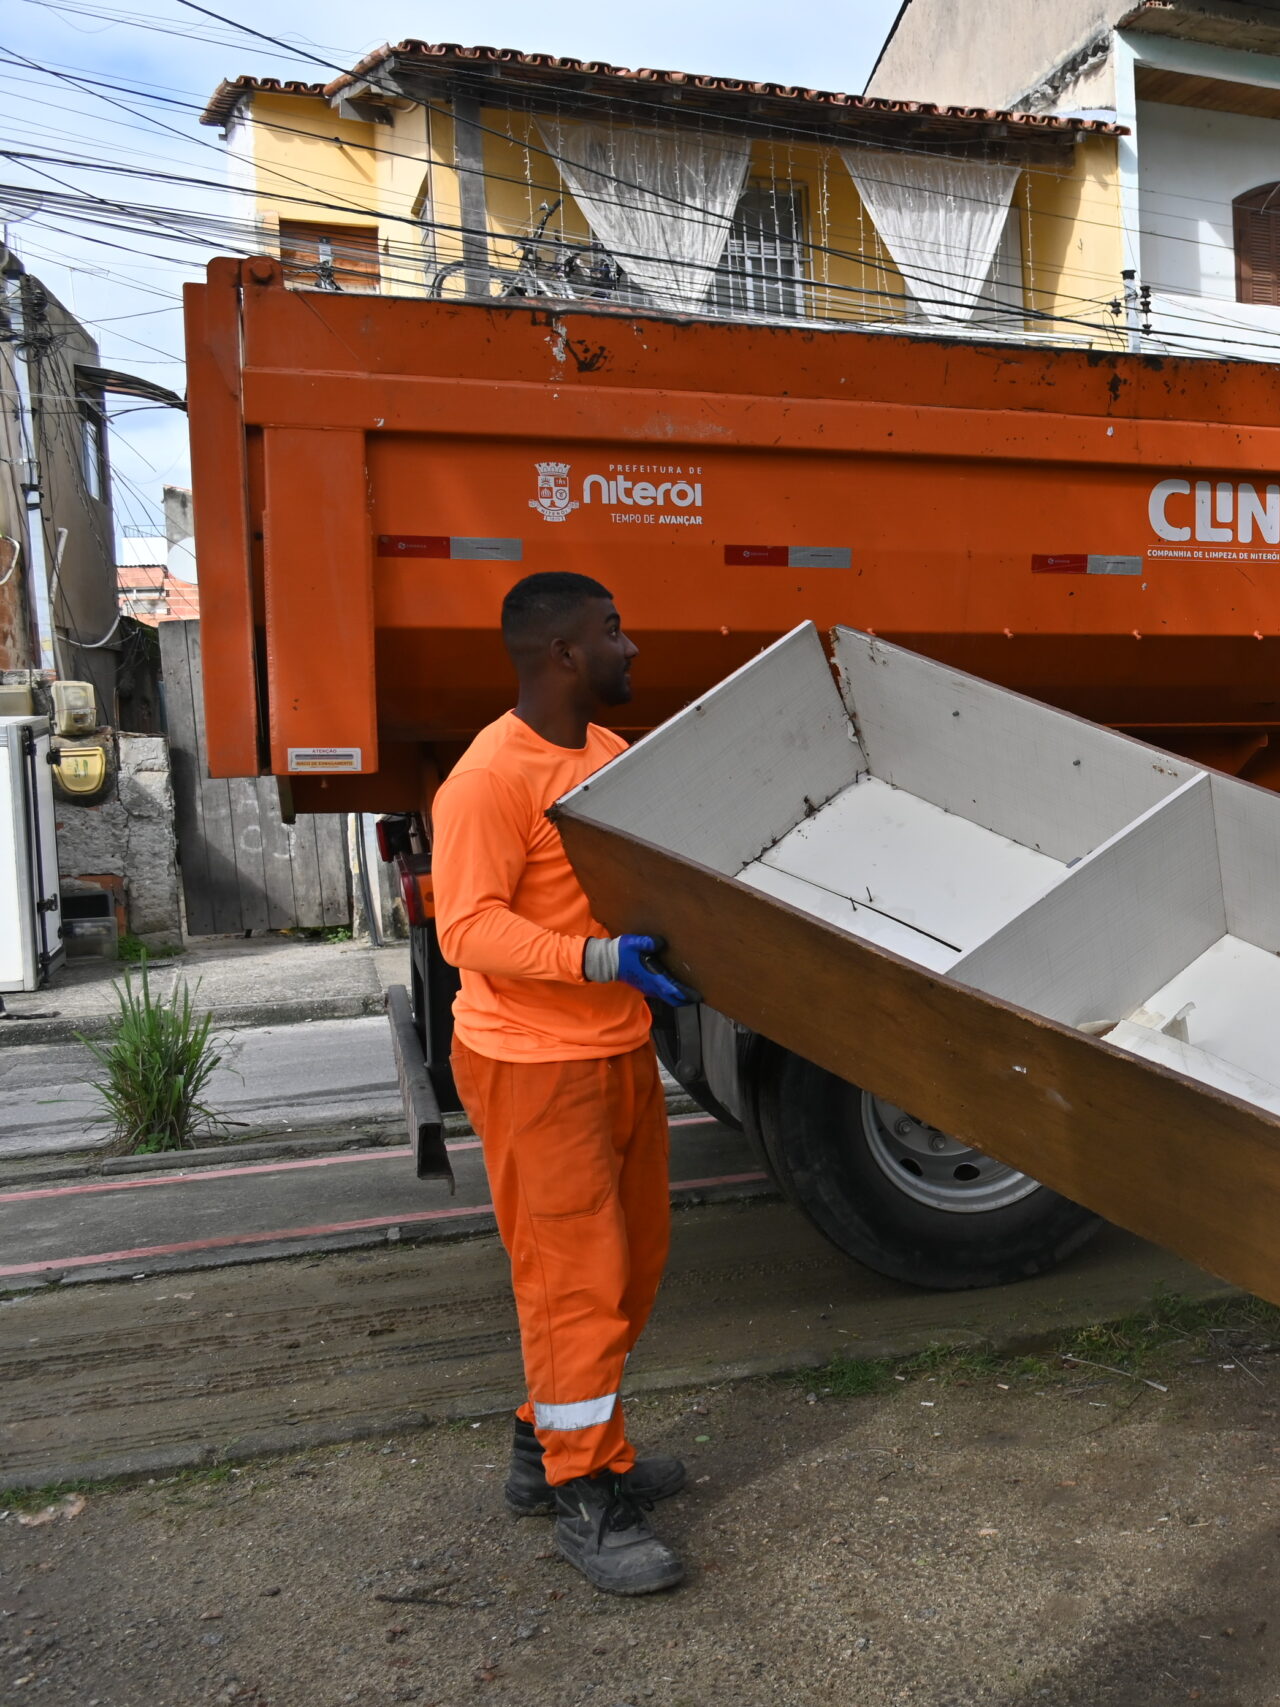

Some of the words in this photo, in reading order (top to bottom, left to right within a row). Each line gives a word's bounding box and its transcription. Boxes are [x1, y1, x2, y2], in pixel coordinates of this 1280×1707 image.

[609, 464, 681, 474] PREFEITURA
[1148, 478, 1280, 544] CLIN
[611, 513, 642, 524] TEMPO
[644, 514, 655, 524] DE
[658, 515, 703, 526] AVANÇAR
[1147, 549, 1192, 559] COMPANHIA
[1193, 550, 1203, 559] DE
[1205, 551, 1237, 560] LIMPEZA
[1239, 552, 1249, 560] DE
[1250, 551, 1280, 561] NITERÓI
